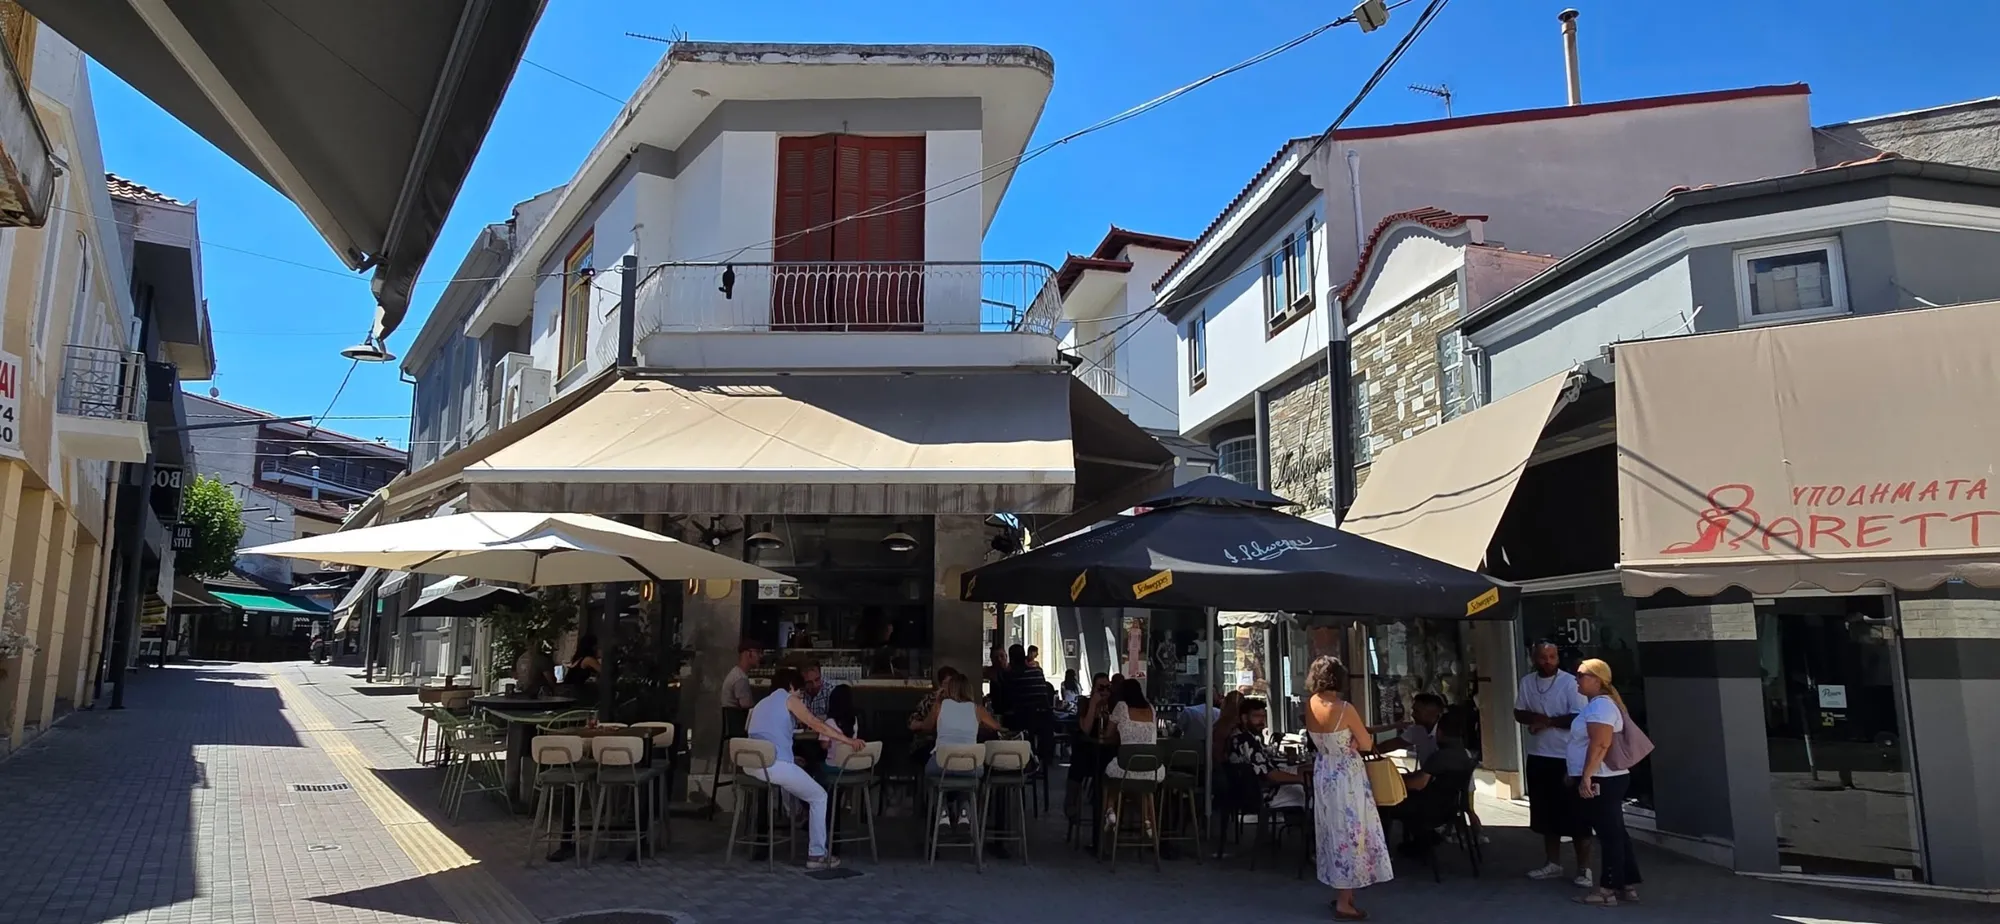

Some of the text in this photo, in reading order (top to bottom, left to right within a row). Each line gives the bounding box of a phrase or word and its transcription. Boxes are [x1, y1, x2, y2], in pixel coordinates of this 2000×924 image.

[0, 361, 16, 399] ΑΙ
[0, 426, 13, 442] 0
[1793, 478, 1987, 506] ΥΠΟΔΗΜΑΤΑ
[178, 527, 192, 538] LIFE
[173, 538, 192, 548] STYLE
[1137, 576, 1168, 594] Schweppes
